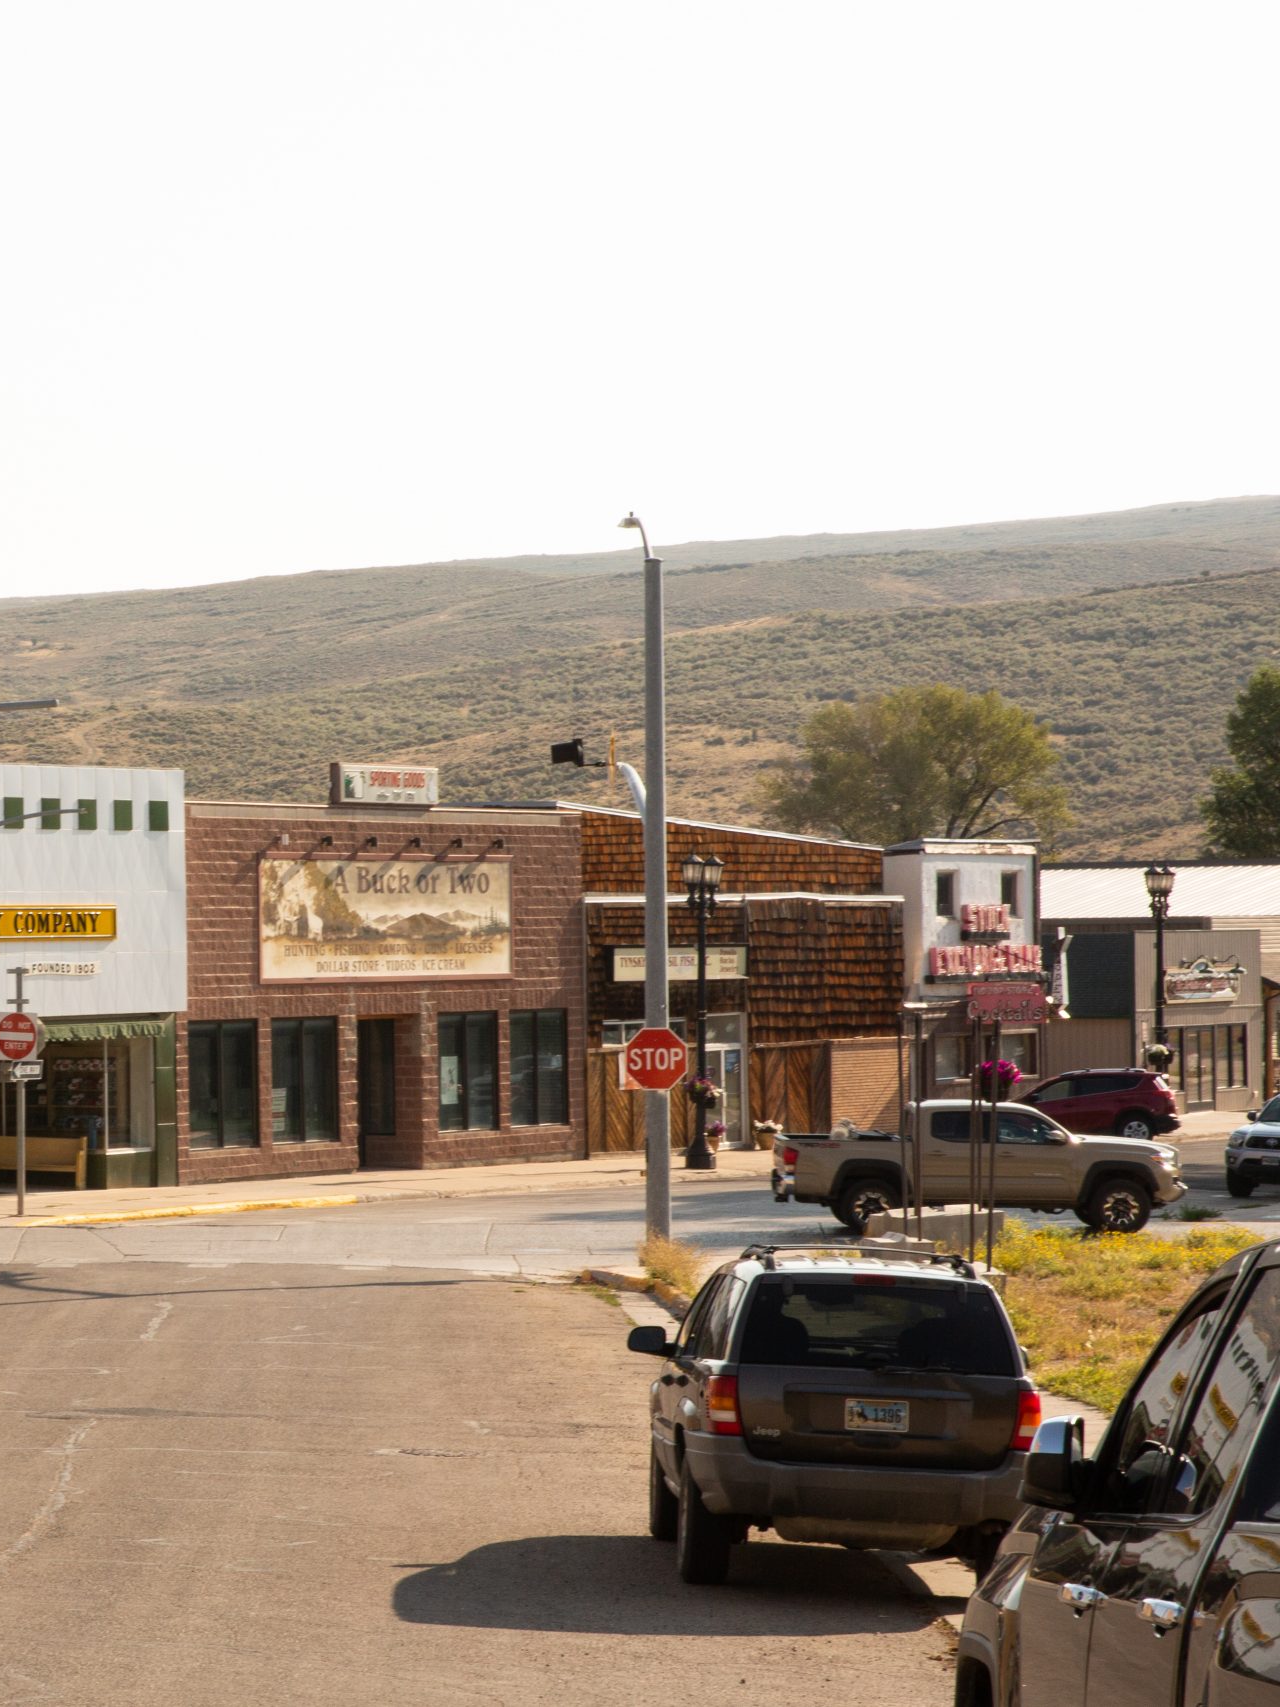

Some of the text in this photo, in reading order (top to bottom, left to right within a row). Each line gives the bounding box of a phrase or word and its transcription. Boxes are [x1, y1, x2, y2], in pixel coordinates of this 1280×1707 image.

[370, 770, 425, 788] SPORTING GOODS
[334, 865, 490, 894] A Buck or Two
[13, 911, 102, 933] COMPANY
[284, 944, 325, 957] HUNTING
[334, 944, 370, 956] FISHING
[378, 943, 417, 955] CAMPING
[455, 942, 494, 954] LICENSES
[31, 964, 96, 975] FOUNDED 1902
[316, 959, 466, 973] DOLLAR STORE VIDEOS ICE CREAM
[2, 1021, 32, 1030] DO NOT
[4, 1041, 28, 1051] ENTER
[629, 1048, 683, 1071] STOP
[752, 1426, 781, 1437] Jeep
